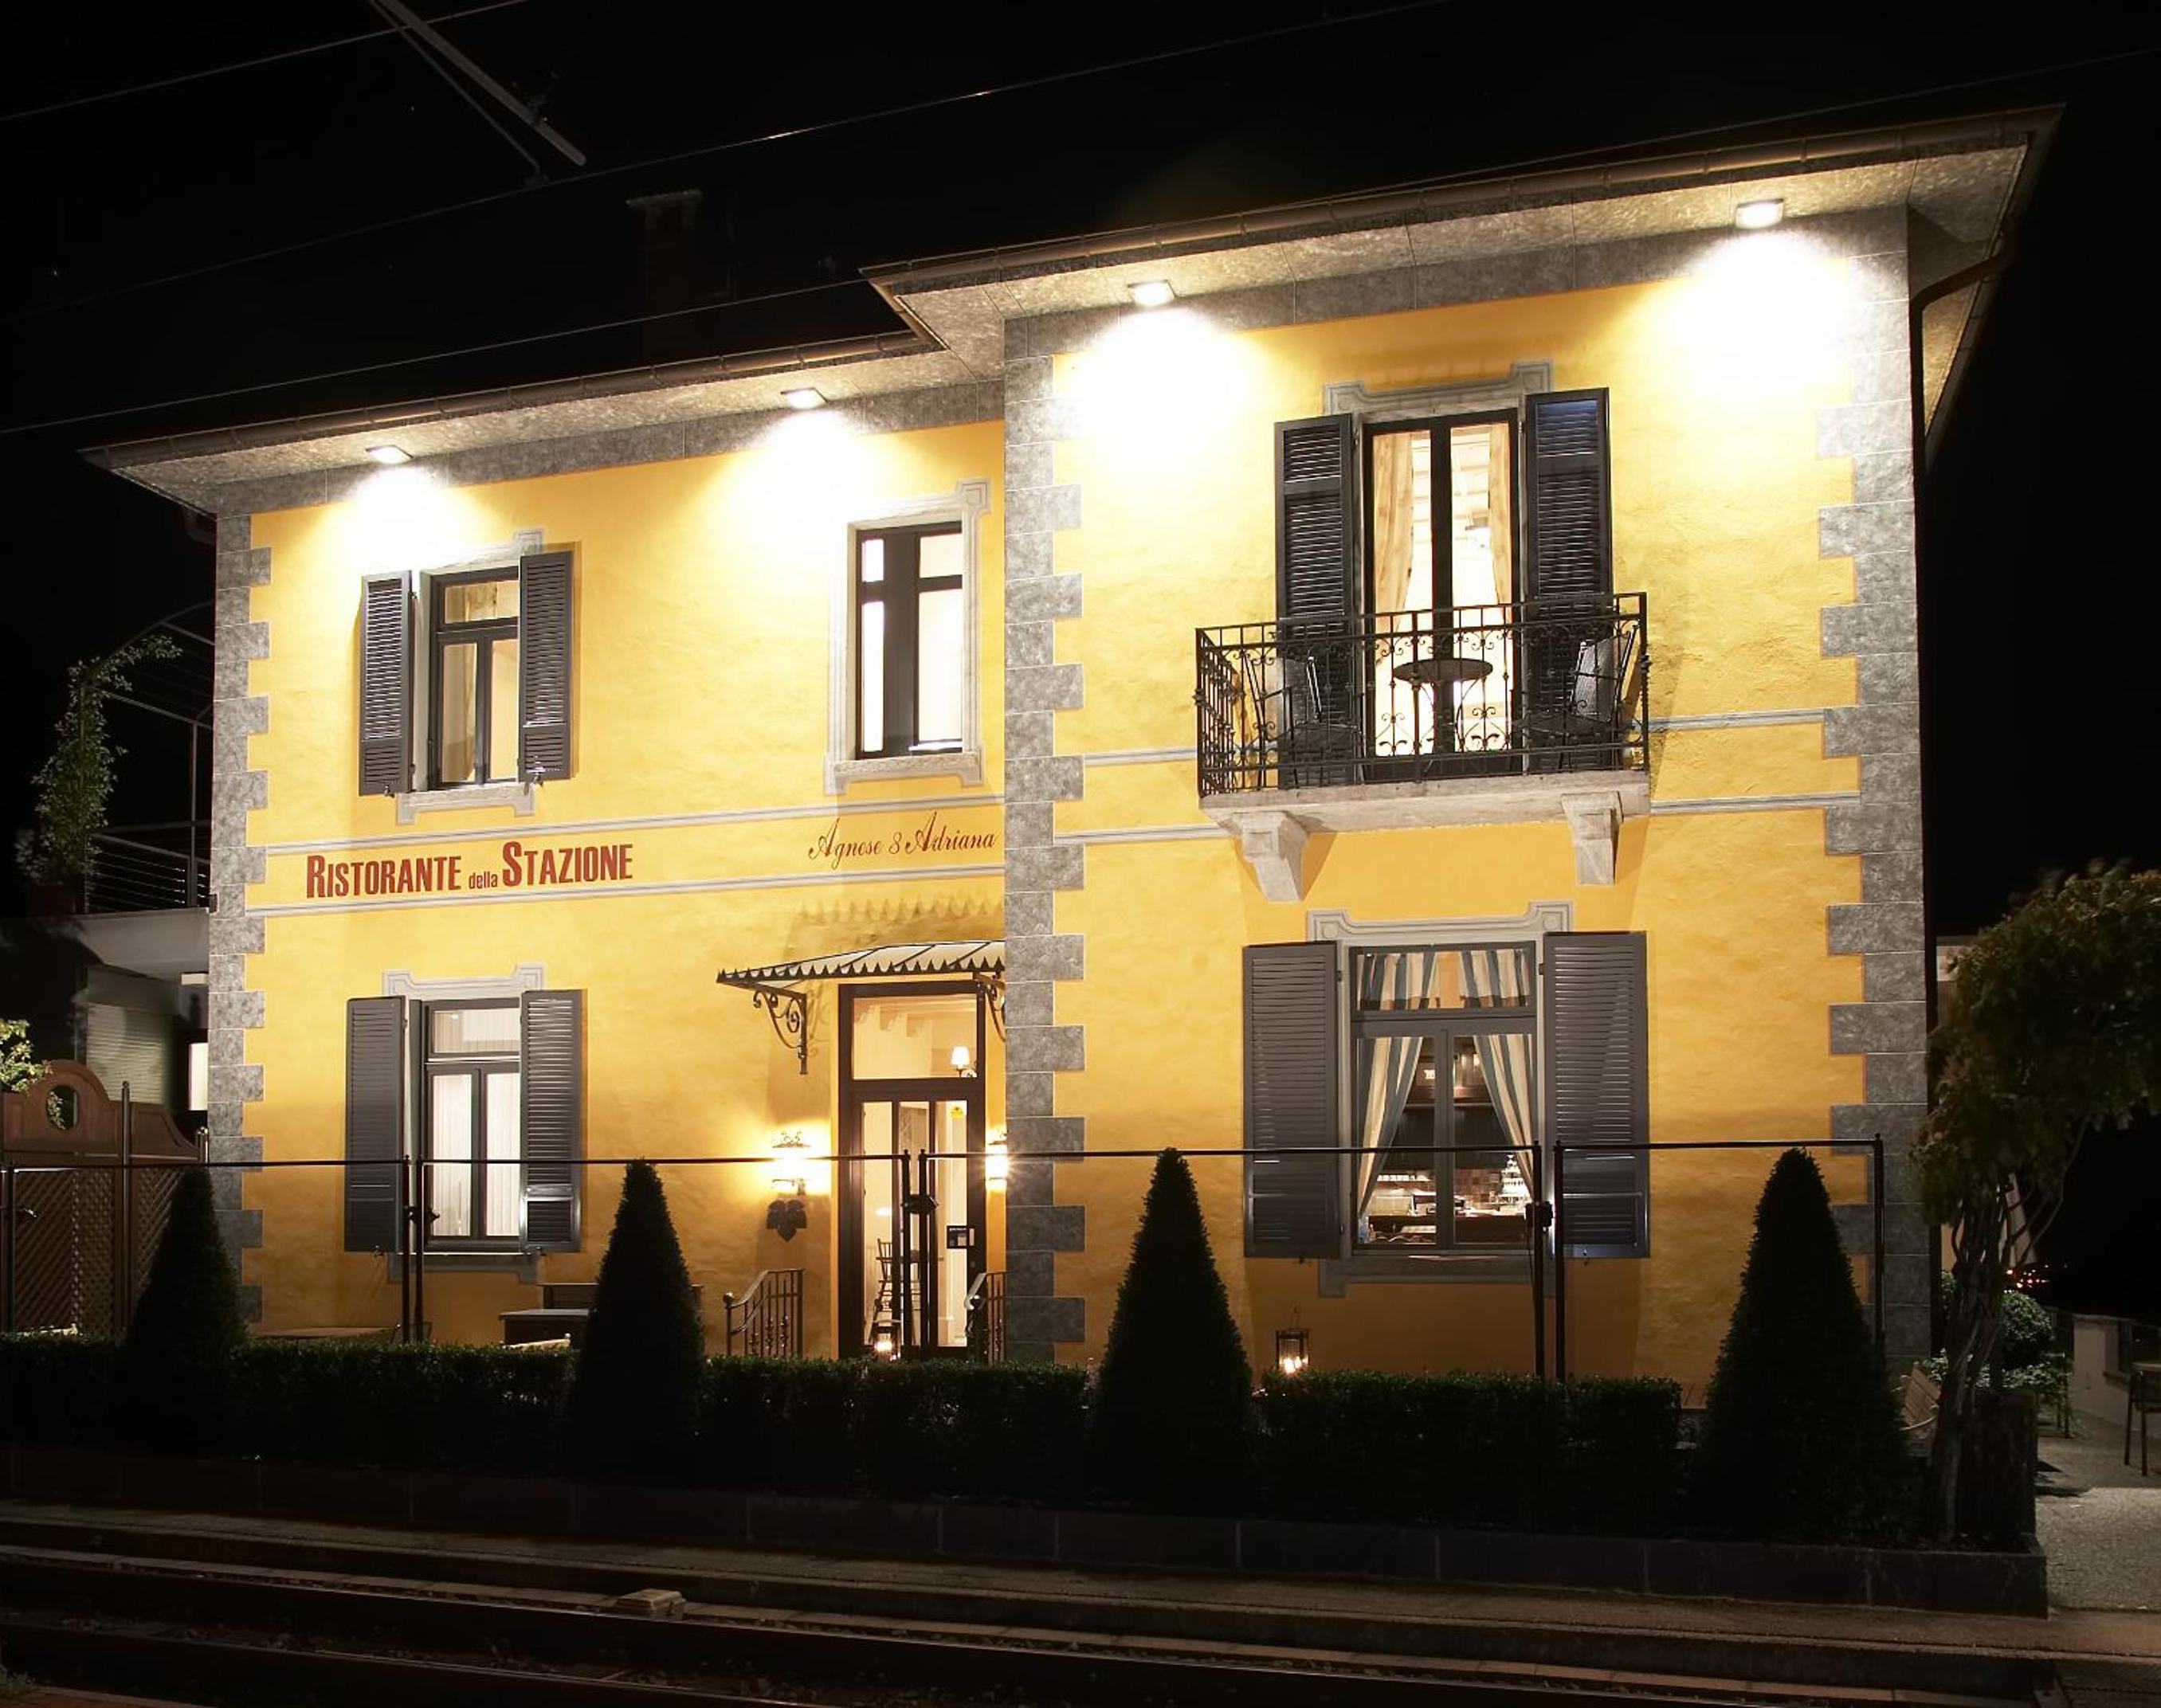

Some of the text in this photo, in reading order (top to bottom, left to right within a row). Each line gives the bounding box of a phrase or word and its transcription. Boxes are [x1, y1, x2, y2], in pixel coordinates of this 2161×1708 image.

[306, 840, 633, 899] RISTORANTE della STAZIONE
[808, 817, 883, 870] Agnese
[905, 811, 996, 855] Adriana
